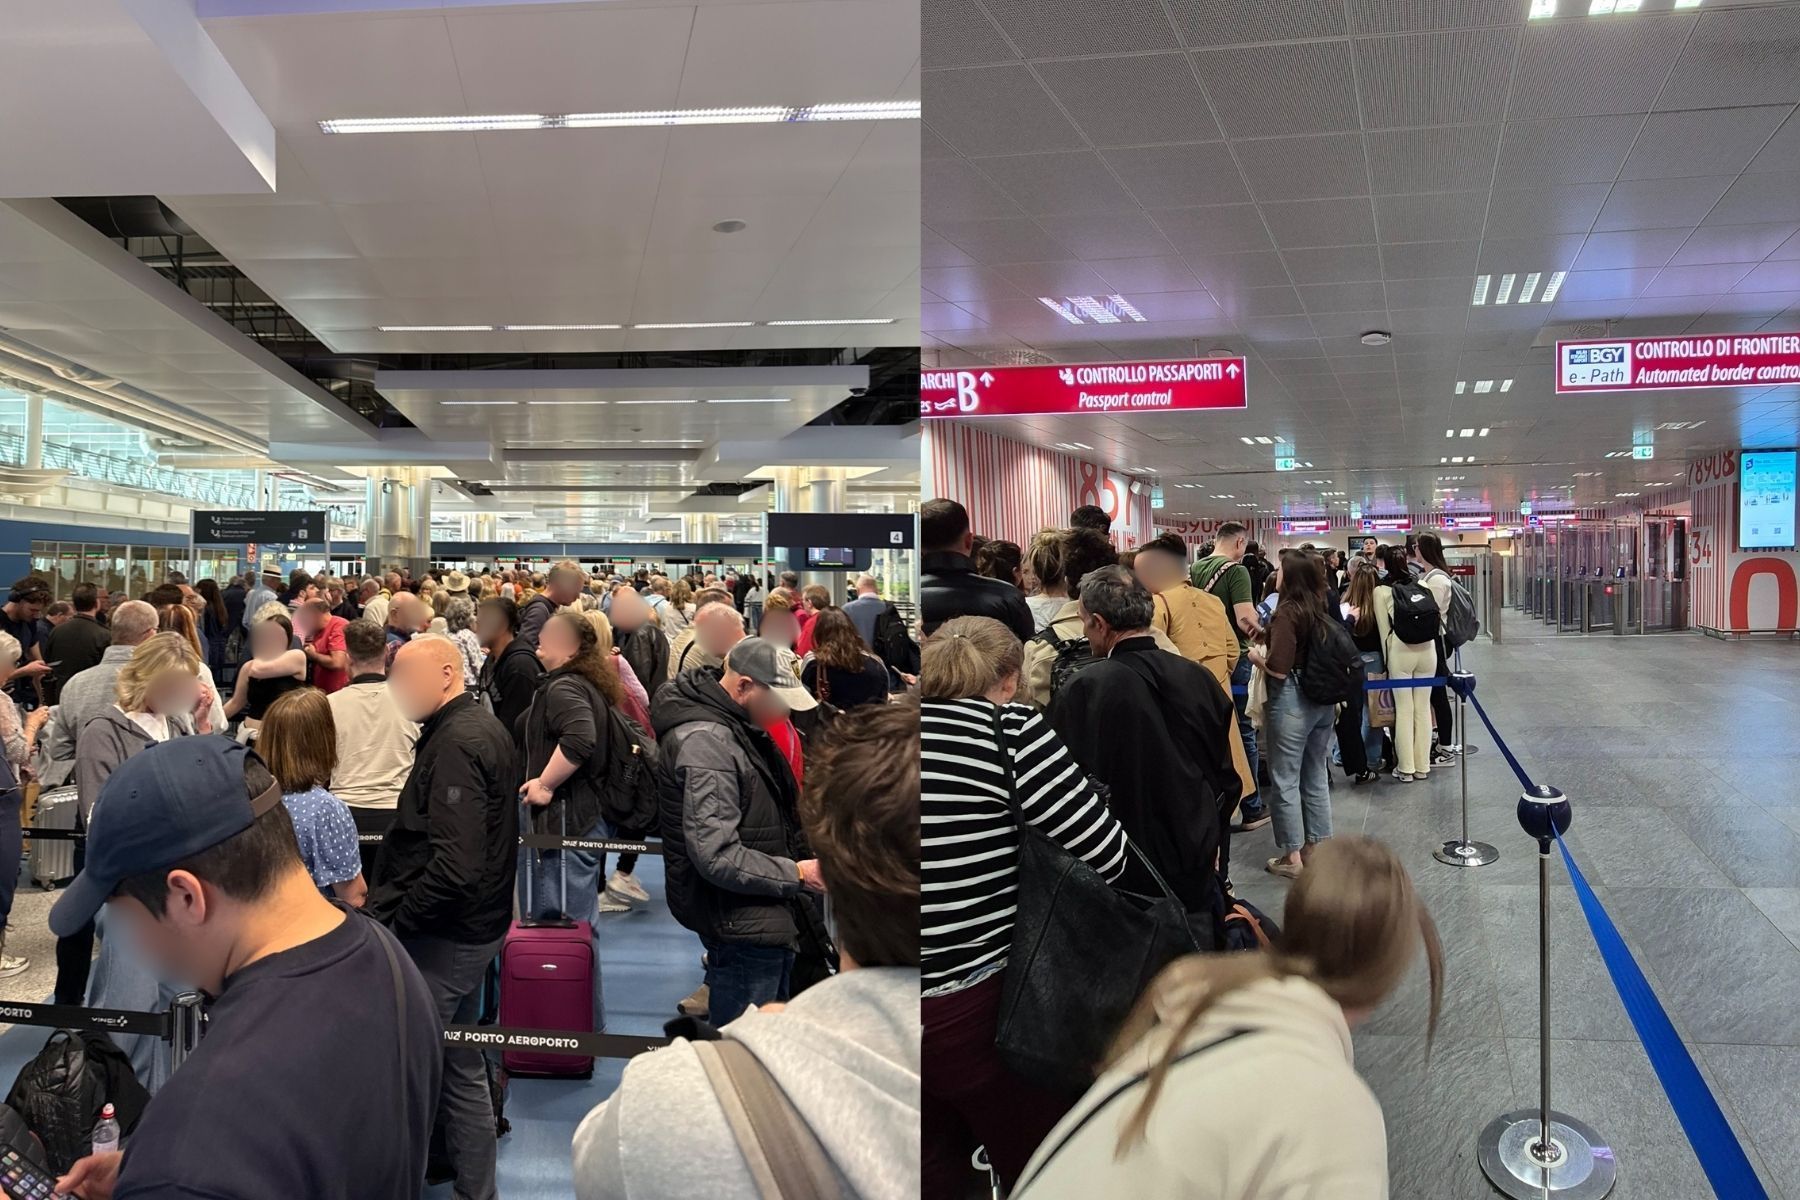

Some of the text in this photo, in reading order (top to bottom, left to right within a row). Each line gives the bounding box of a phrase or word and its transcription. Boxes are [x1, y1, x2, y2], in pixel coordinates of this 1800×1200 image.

[1590, 348, 1622, 363] BGY
[1635, 339, 1713, 359] CONTROLLO
[1716, 338, 1730, 356] DI
[1077, 362, 1222, 385] CONTROLLO PASSAPORTI
[1635, 362, 1800, 384] Automated border contro
[957, 371, 979, 412] B
[1078, 388, 1171, 408] Passport control
[604, 843, 647, 851] AEROPORTO
[465, 1031, 505, 1044] PORTO
[508, 1035, 579, 1048] AEROPORTO
